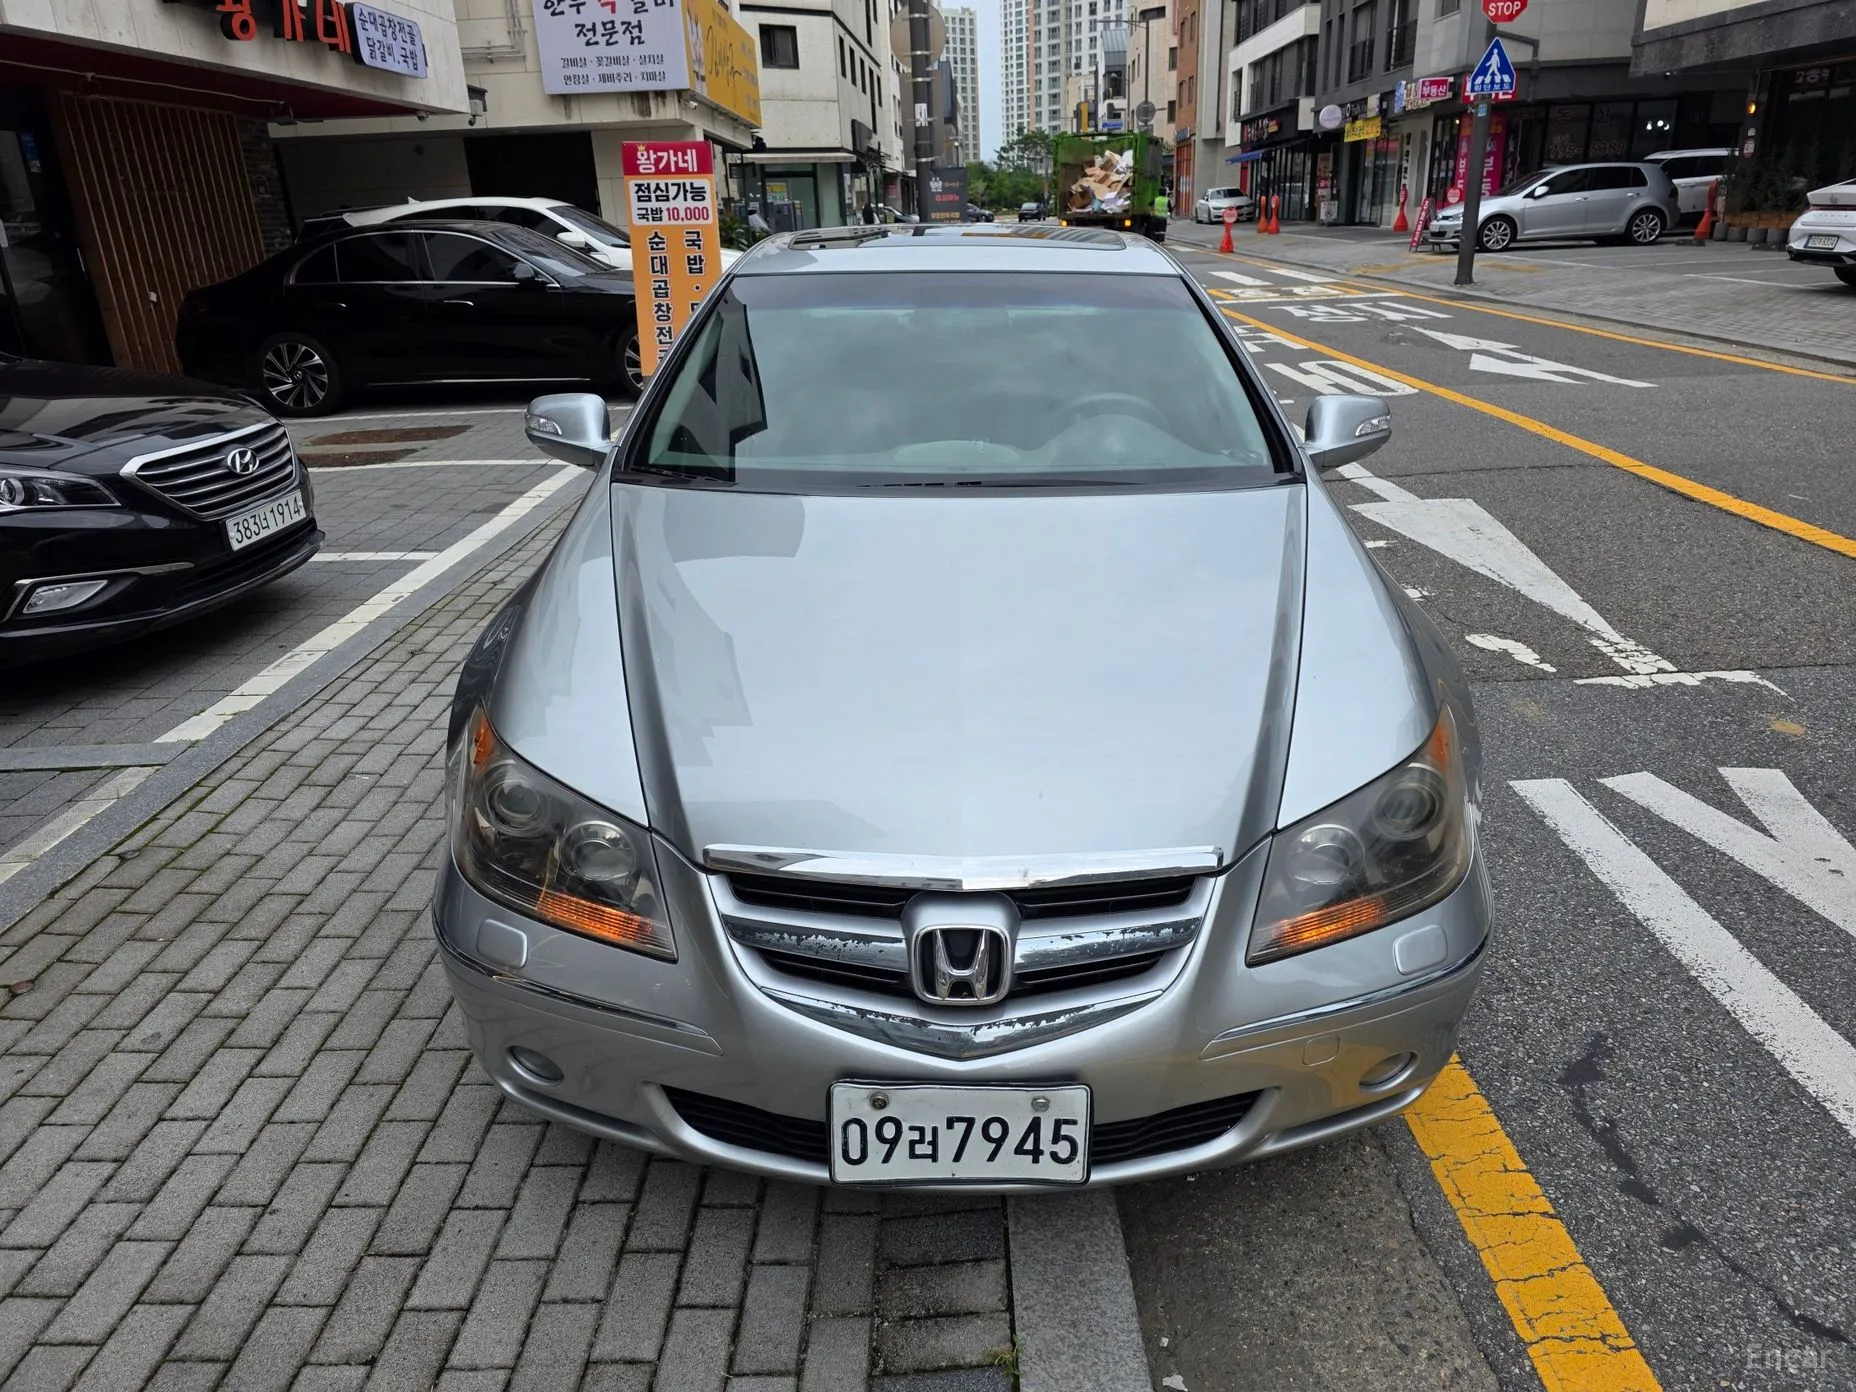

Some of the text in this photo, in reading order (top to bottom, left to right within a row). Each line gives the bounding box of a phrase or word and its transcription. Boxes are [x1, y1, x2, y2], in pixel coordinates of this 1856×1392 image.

[1488, 1, 1521, 16] STOP
[358, 7, 417, 46] 순대곱창전골
[574, 19, 645, 47] 전문점
[560, 53, 665, 69] 갈비살 꽃갈비살 살치살
[563, 70, 667, 87] 안창살 제비추리 치마살
[1422, 84, 1447, 97] 부동산
[636, 148, 698, 173] 왕가네
[634, 181, 707, 203] 점심가능
[636, 205, 710, 222] 국밥 10,000
[841, 1115, 1079, 1166] 09러7945
